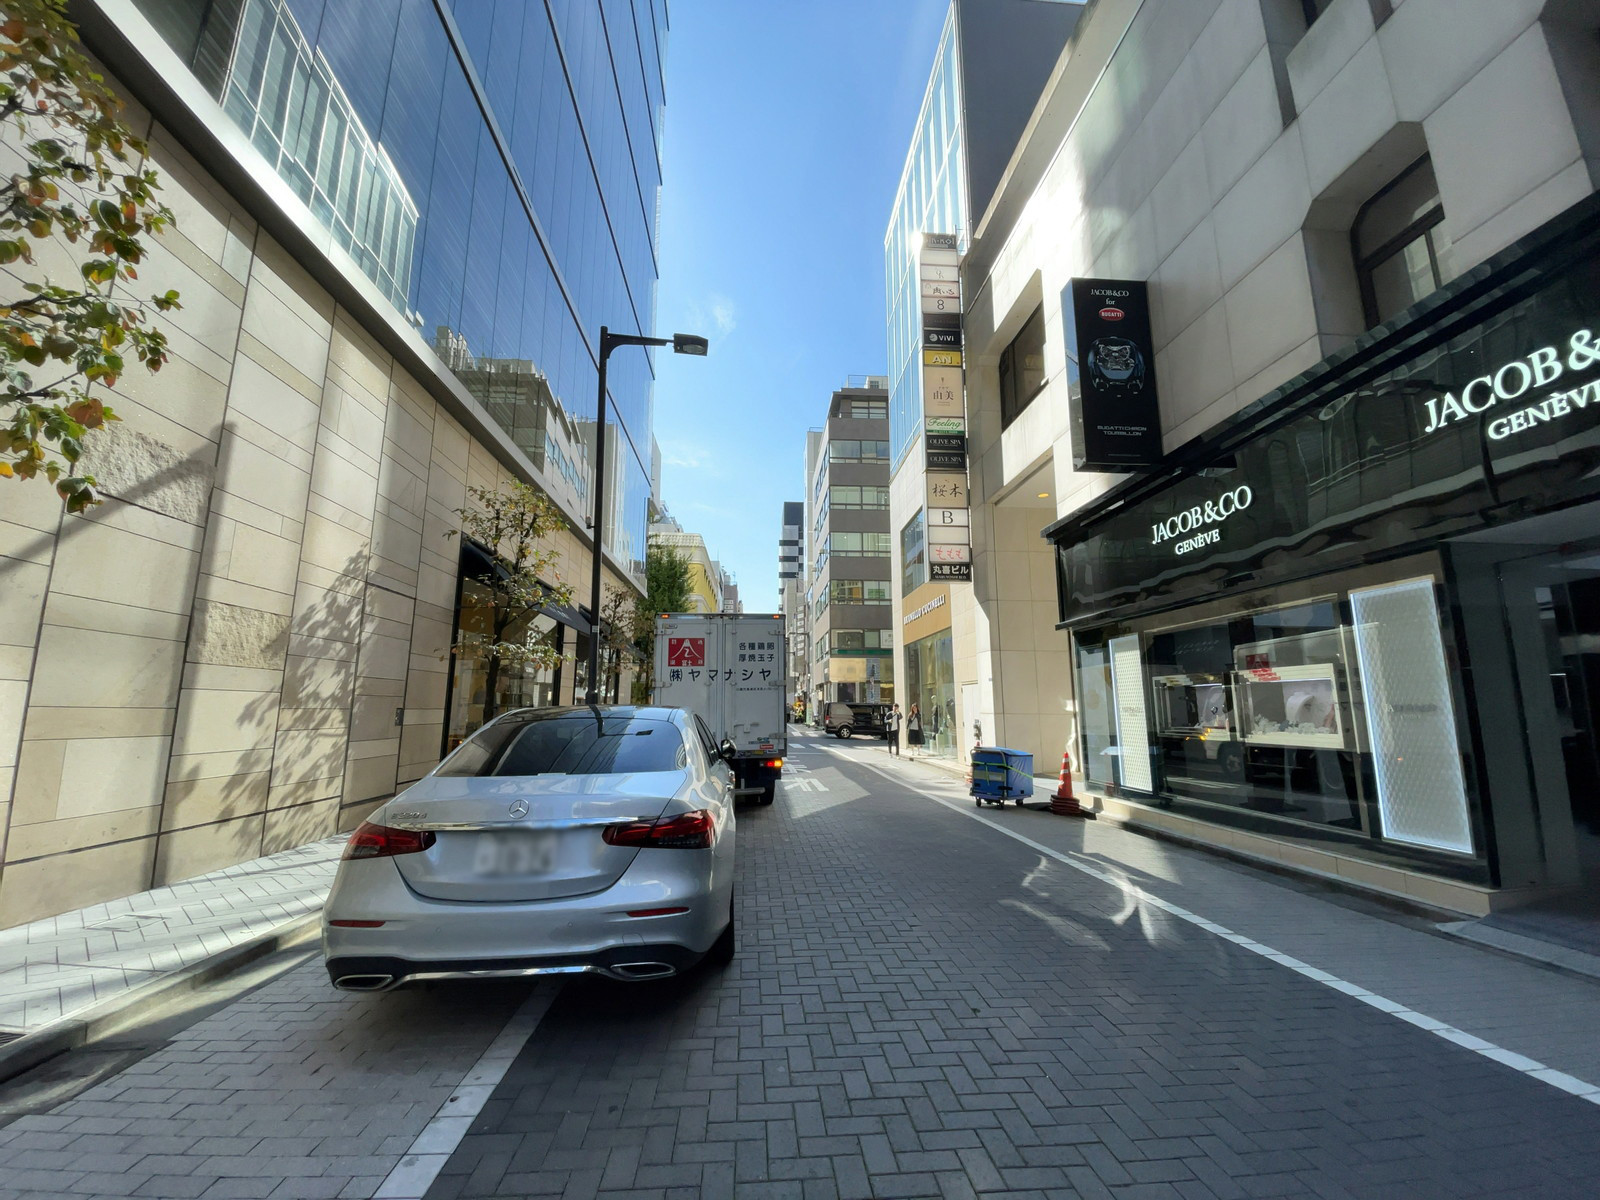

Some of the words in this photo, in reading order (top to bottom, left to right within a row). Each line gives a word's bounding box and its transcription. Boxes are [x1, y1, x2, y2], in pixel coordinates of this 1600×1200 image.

[936, 299, 945, 311] 8
[927, 416, 962, 430] Feeling
[950, 455, 962, 463] SPA
[942, 510, 954, 525] B
[1151, 485, 1252, 545] JACOB&CO
[1174, 528, 1221, 555] GENÈVE
[932, 565, 969, 575] 丸喜ビル
[738, 653, 775, 663] 厚焼玉子
